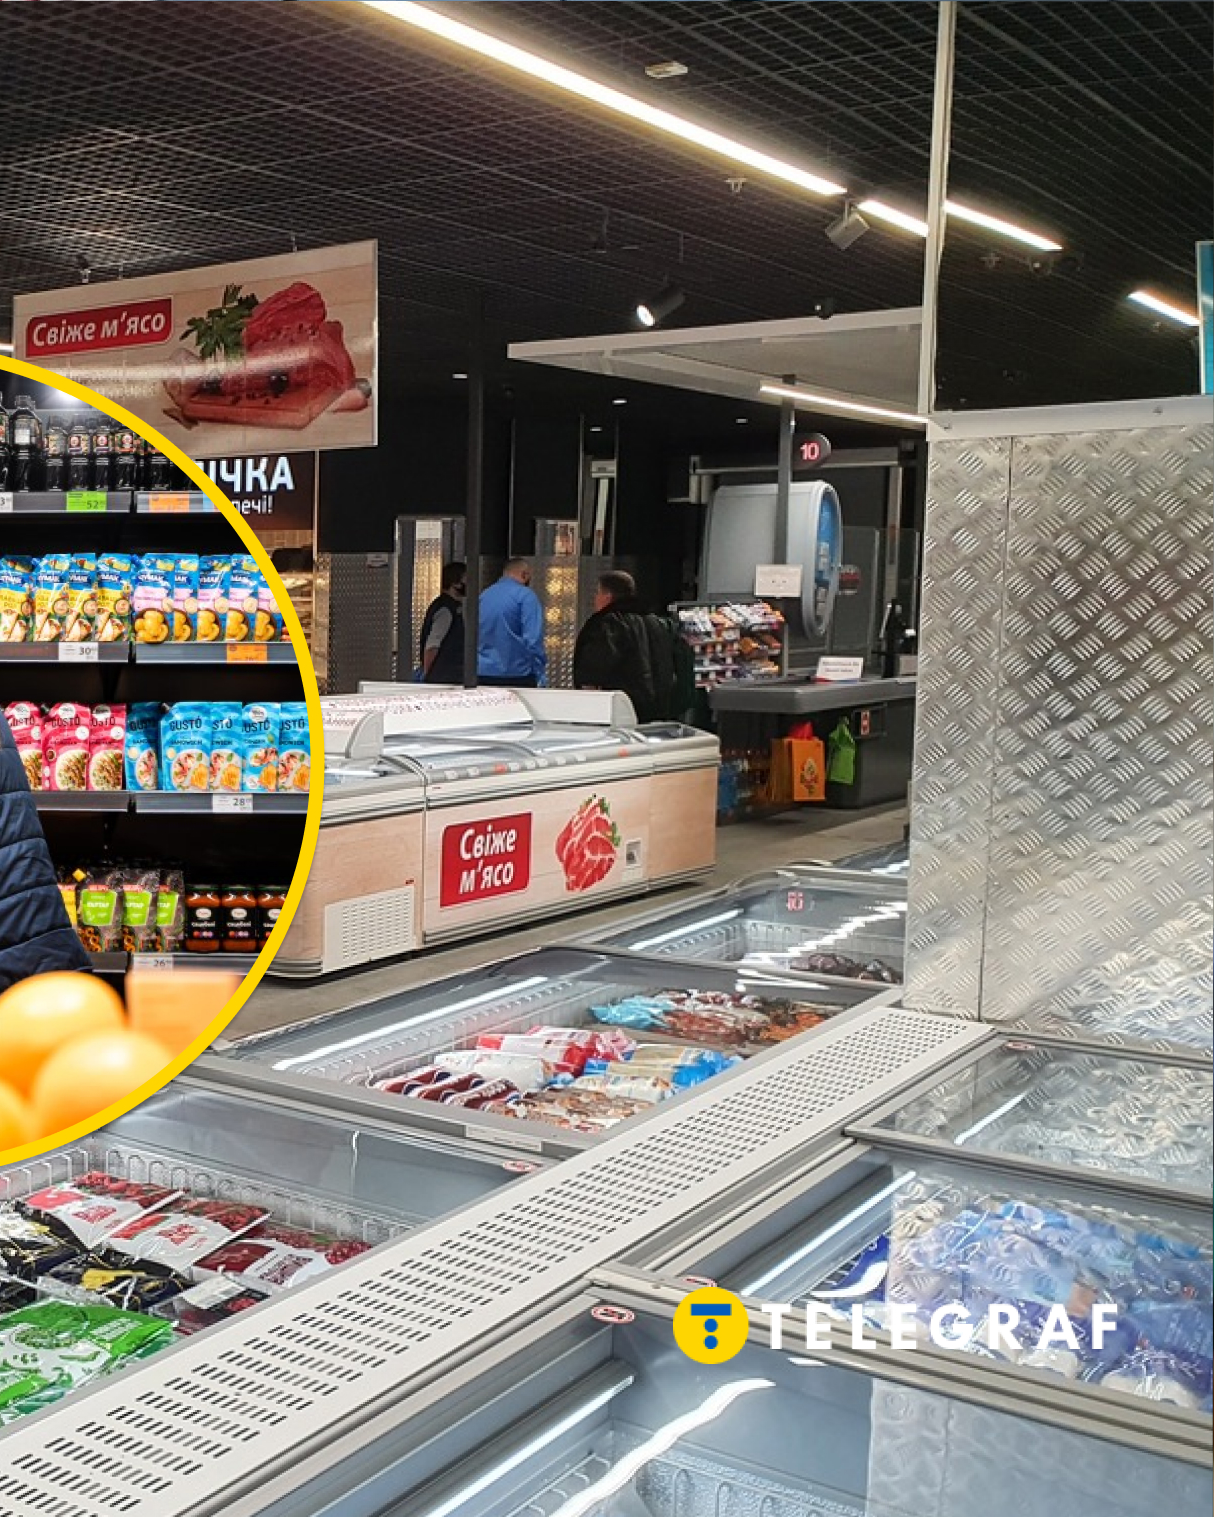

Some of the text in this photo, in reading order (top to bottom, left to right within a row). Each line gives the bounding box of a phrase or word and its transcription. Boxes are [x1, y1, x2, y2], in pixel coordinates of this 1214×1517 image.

[32, 318, 94, 347] Свіже
[799, 442, 820, 460] 10
[459, 822, 517, 861] Свіже
